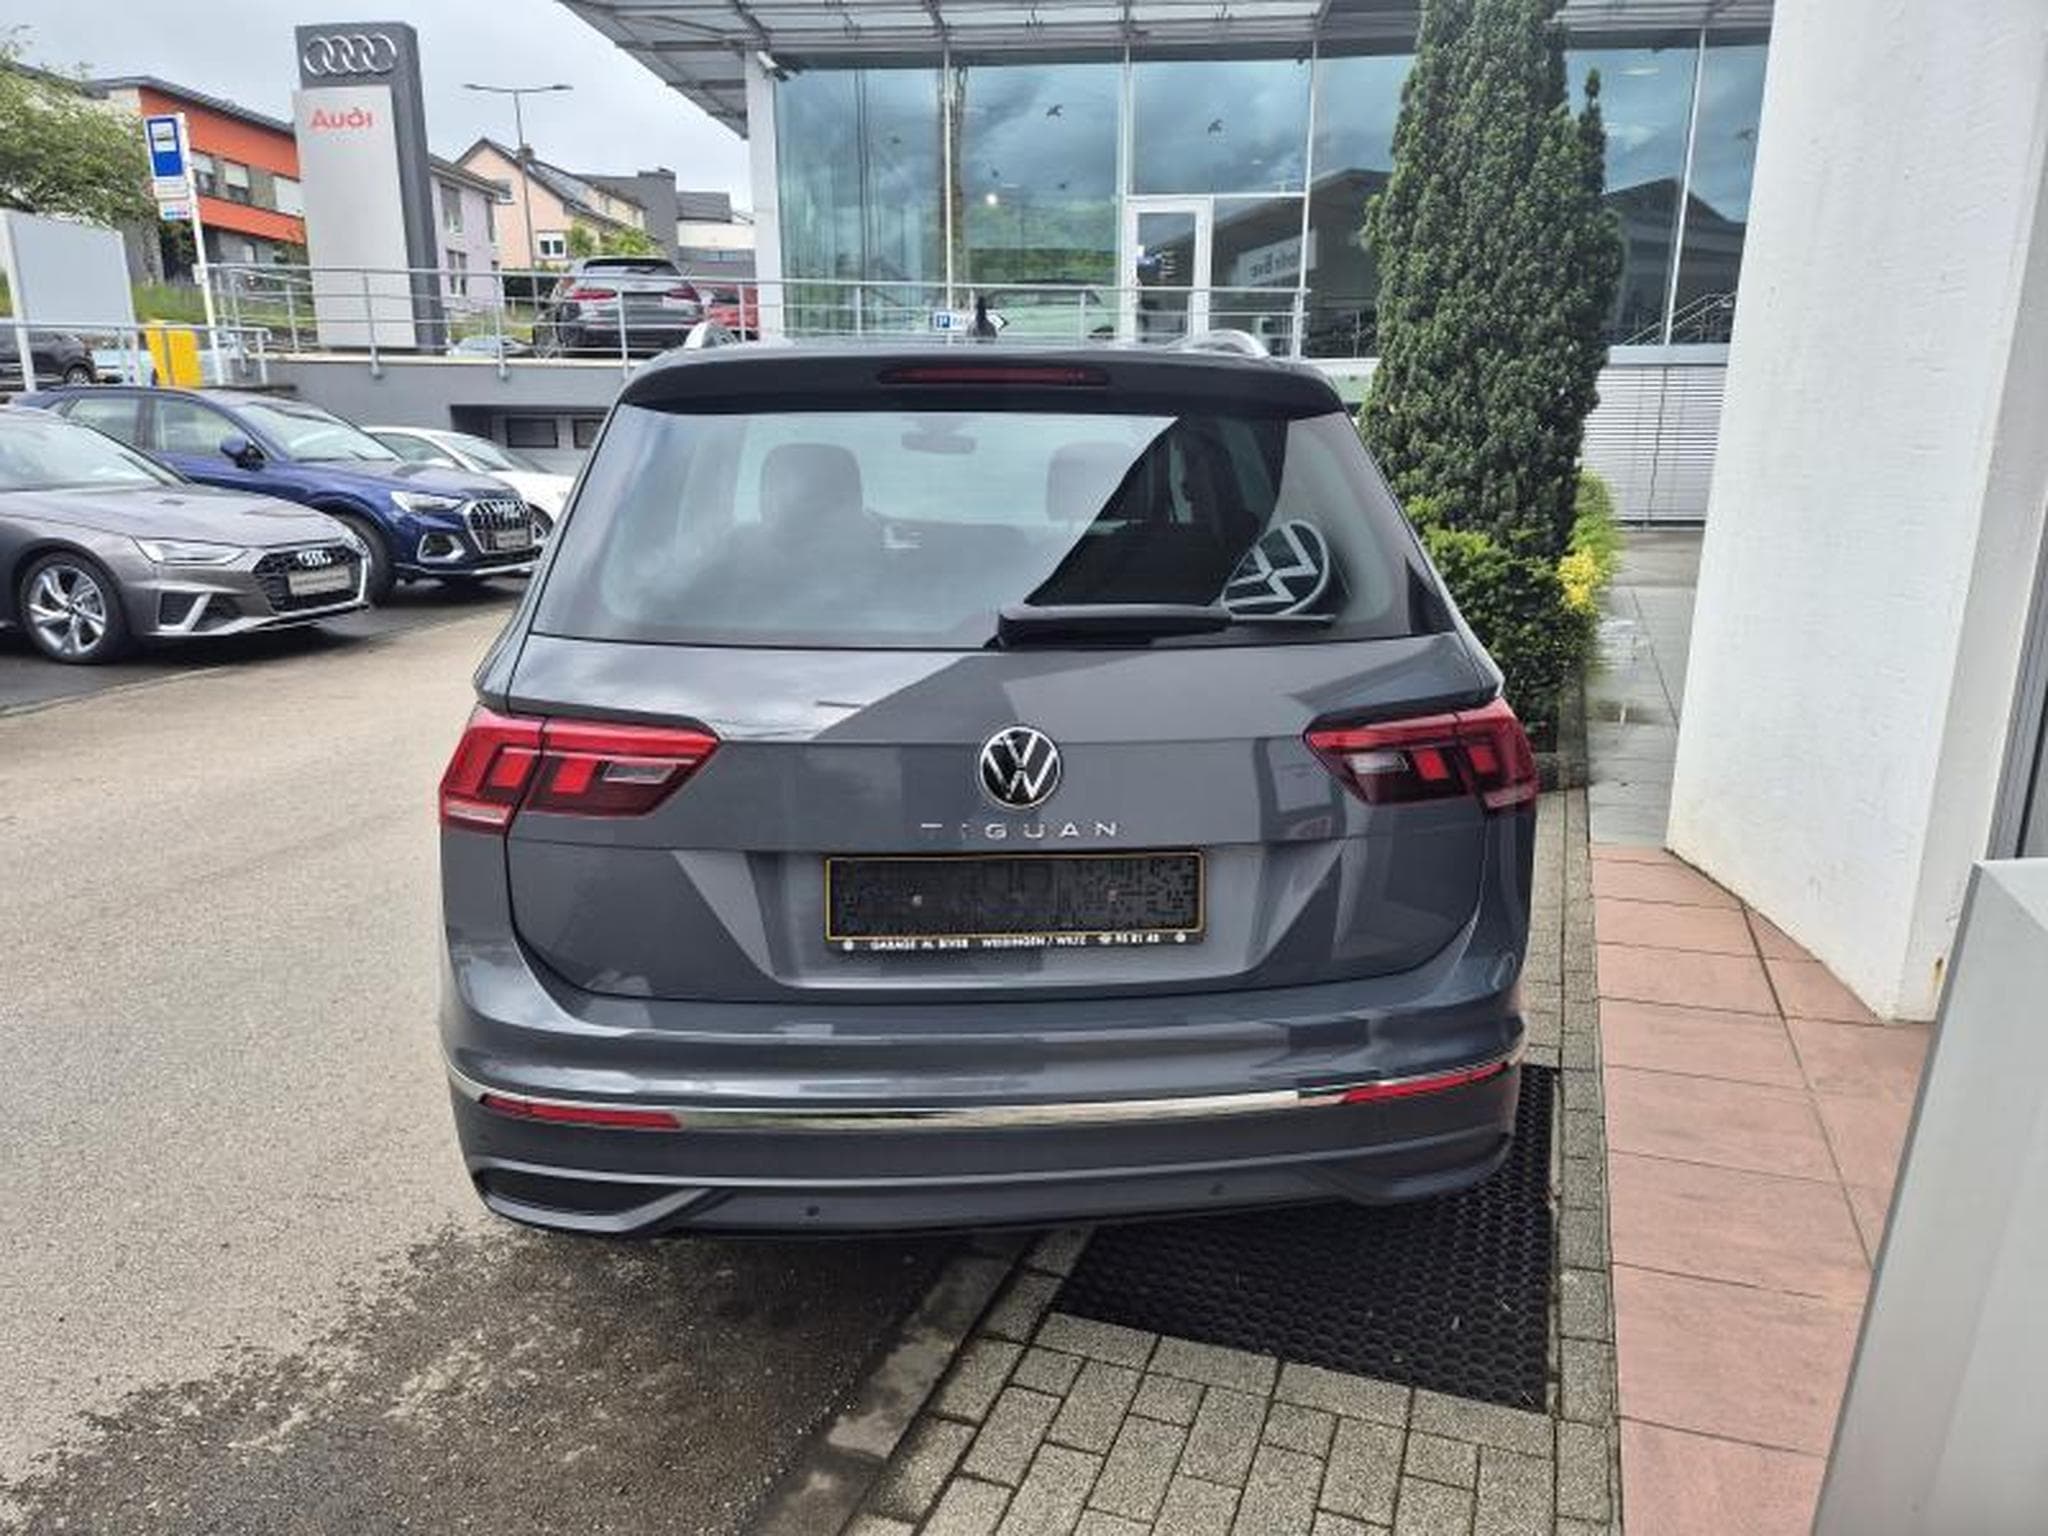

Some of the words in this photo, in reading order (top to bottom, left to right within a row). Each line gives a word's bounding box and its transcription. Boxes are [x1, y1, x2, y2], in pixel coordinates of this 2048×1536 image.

[310, 106, 372, 129] Audi
[980, 727, 1061, 808] VW
[920, 821, 1118, 839] TIGUAN
